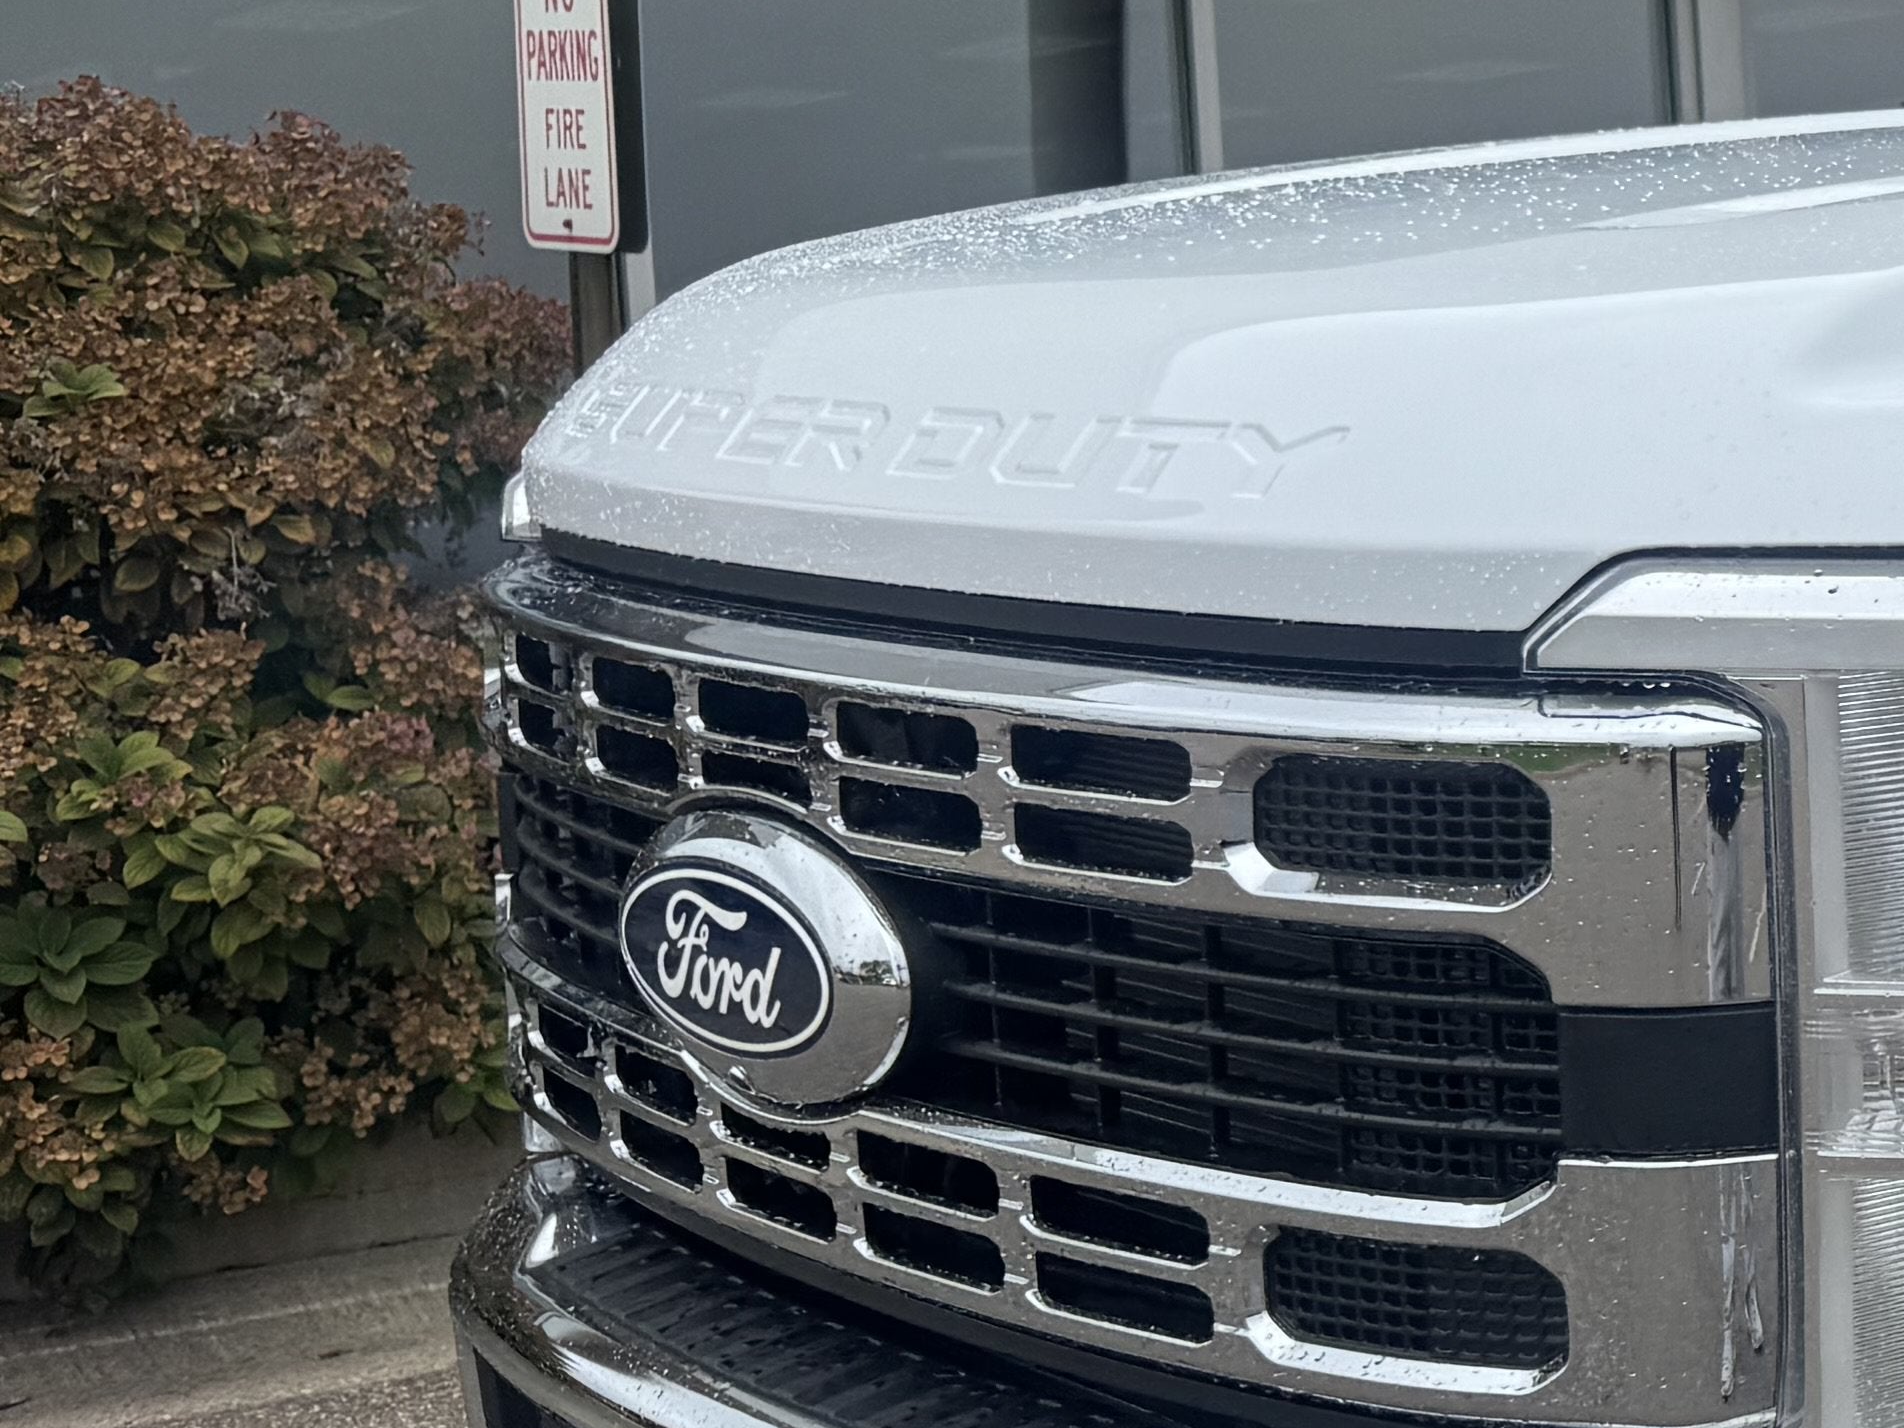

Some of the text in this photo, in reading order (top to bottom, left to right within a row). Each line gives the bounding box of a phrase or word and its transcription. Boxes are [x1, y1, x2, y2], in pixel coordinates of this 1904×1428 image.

[526, 29, 600, 82] PARKING
[545, 108, 587, 150] FIRE
[544, 167, 593, 210] LANE
[886, 404, 1352, 499] DUTY
[657, 889, 782, 1028] Ford
